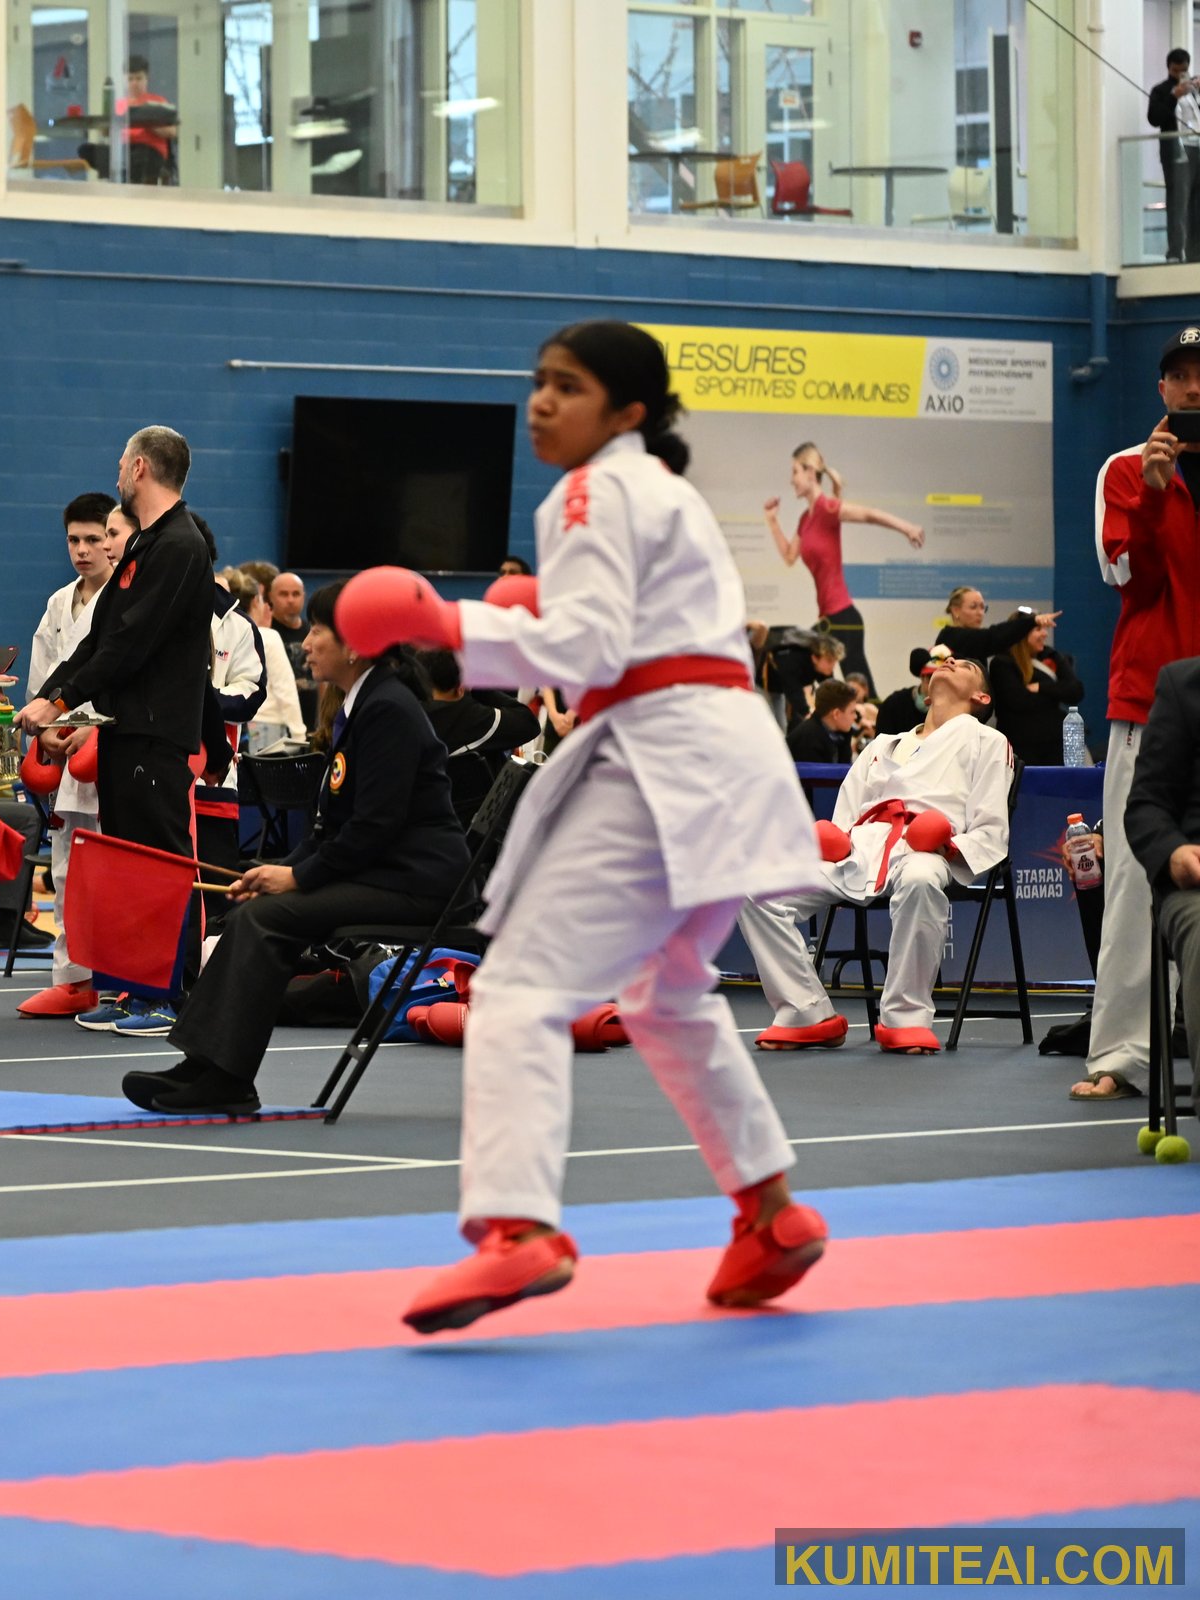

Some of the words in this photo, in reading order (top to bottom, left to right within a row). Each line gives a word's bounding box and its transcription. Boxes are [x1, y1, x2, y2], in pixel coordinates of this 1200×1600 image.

[657, 341, 807, 375] LESSURES
[694, 375, 797, 399] SPORTIVES
[803, 379, 911, 404] COMMUNES
